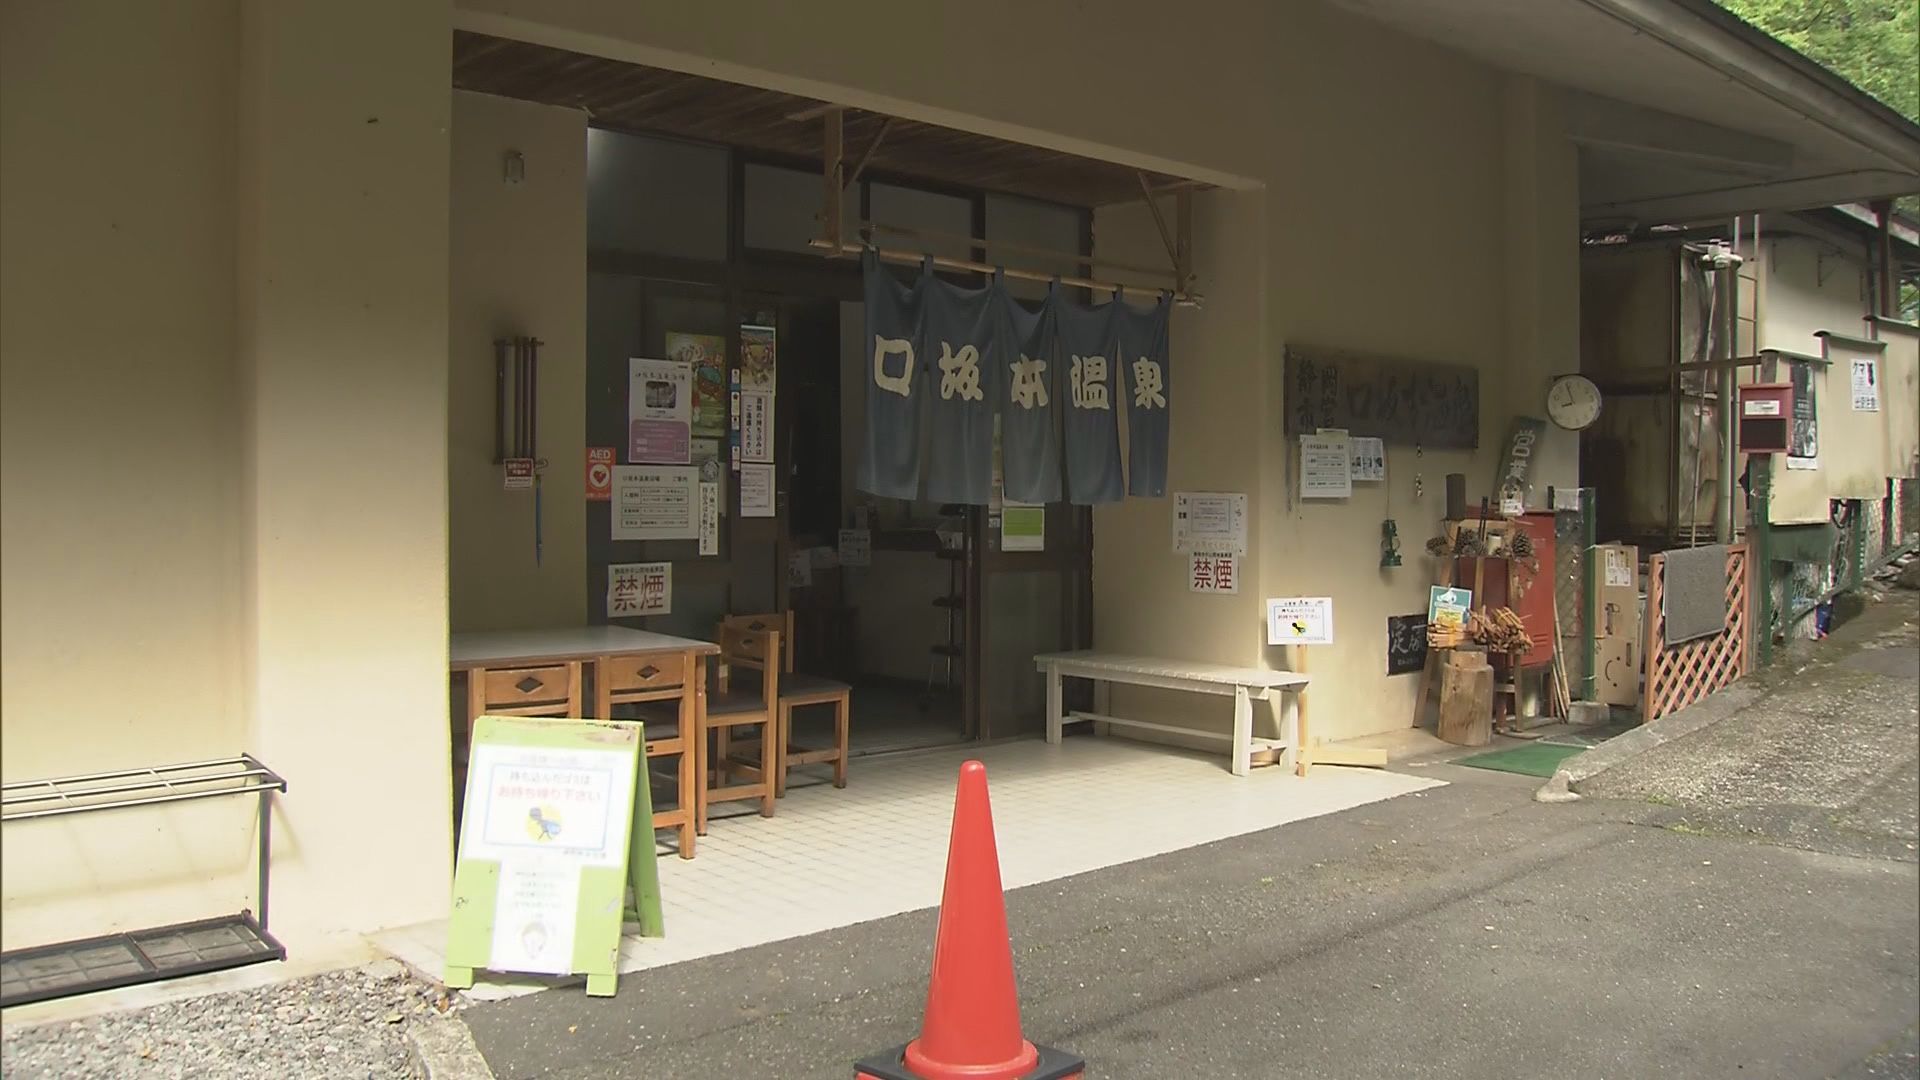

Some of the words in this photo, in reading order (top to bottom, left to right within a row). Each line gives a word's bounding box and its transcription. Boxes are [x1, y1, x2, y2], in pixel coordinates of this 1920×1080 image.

[873, 334, 1166, 410] 口坂本温泉
[590, 449, 611, 459] AED
[1193, 558, 1232, 589] 禁煙
[614, 574, 664, 611] 禁煙
[498, 786, 601, 801] お持ち帰り下さい
